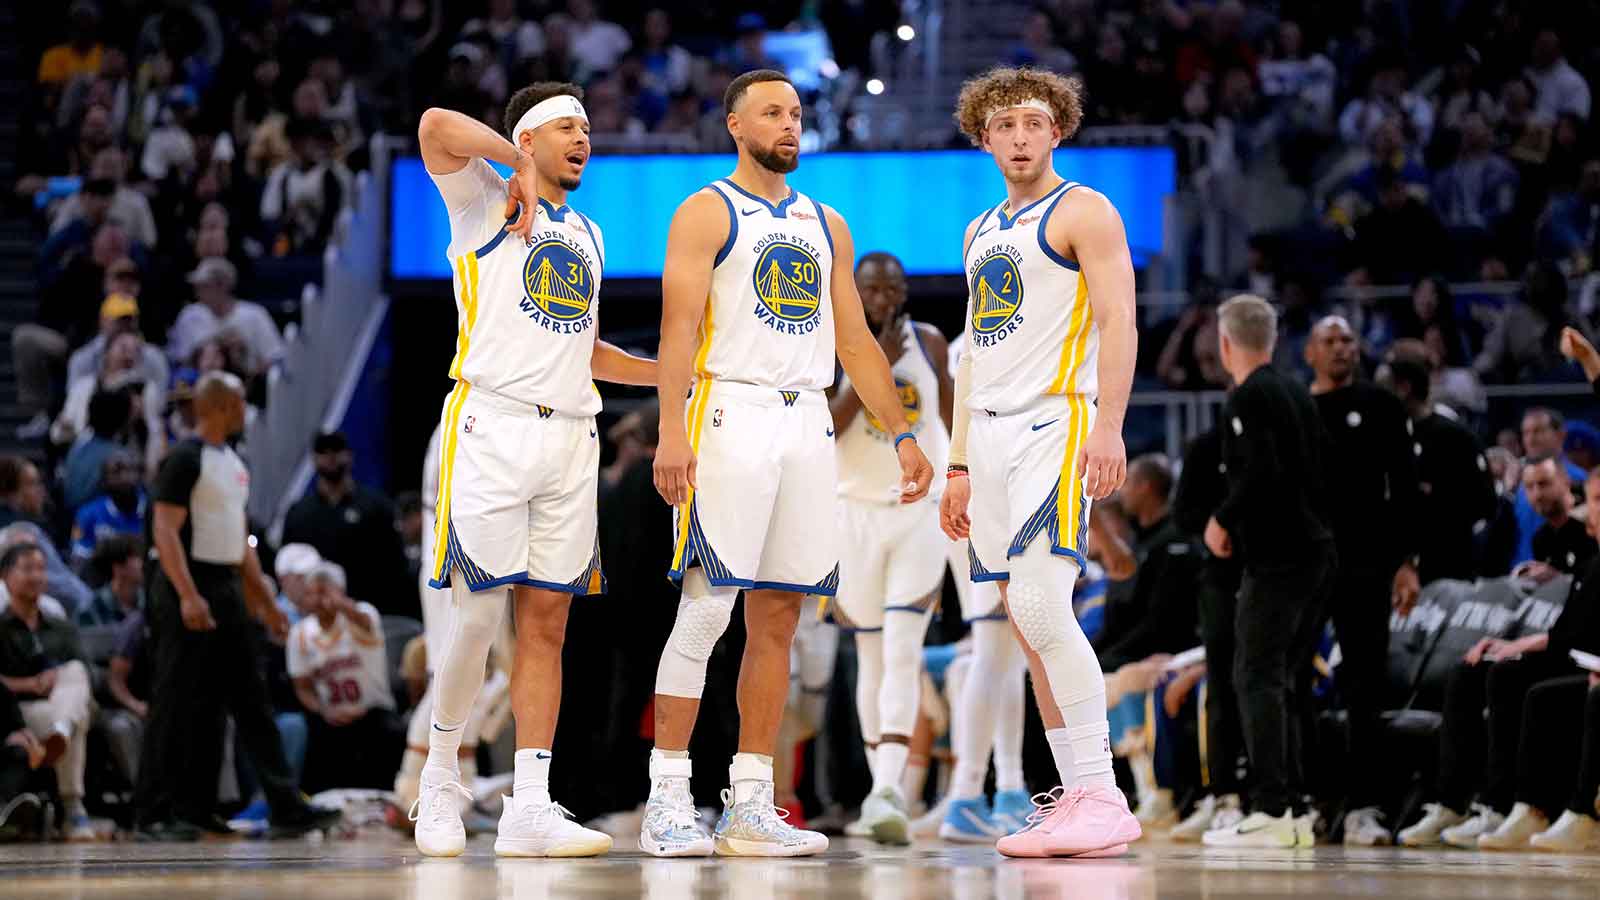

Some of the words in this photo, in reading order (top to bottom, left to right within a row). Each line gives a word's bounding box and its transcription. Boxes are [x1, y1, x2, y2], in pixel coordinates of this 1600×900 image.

[525, 231, 565, 249] GOLDEN
[568, 240, 593, 267] STATE
[753, 232, 787, 255] GOLDEN
[791, 235, 821, 261] STATE
[969, 243, 1003, 274] GOLDEN
[1005, 244, 1024, 267] STATE
[567, 262, 584, 286] 31
[790, 261, 815, 284] 30
[1001, 271, 1012, 294] 2
[518, 296, 593, 334] WARRIORS
